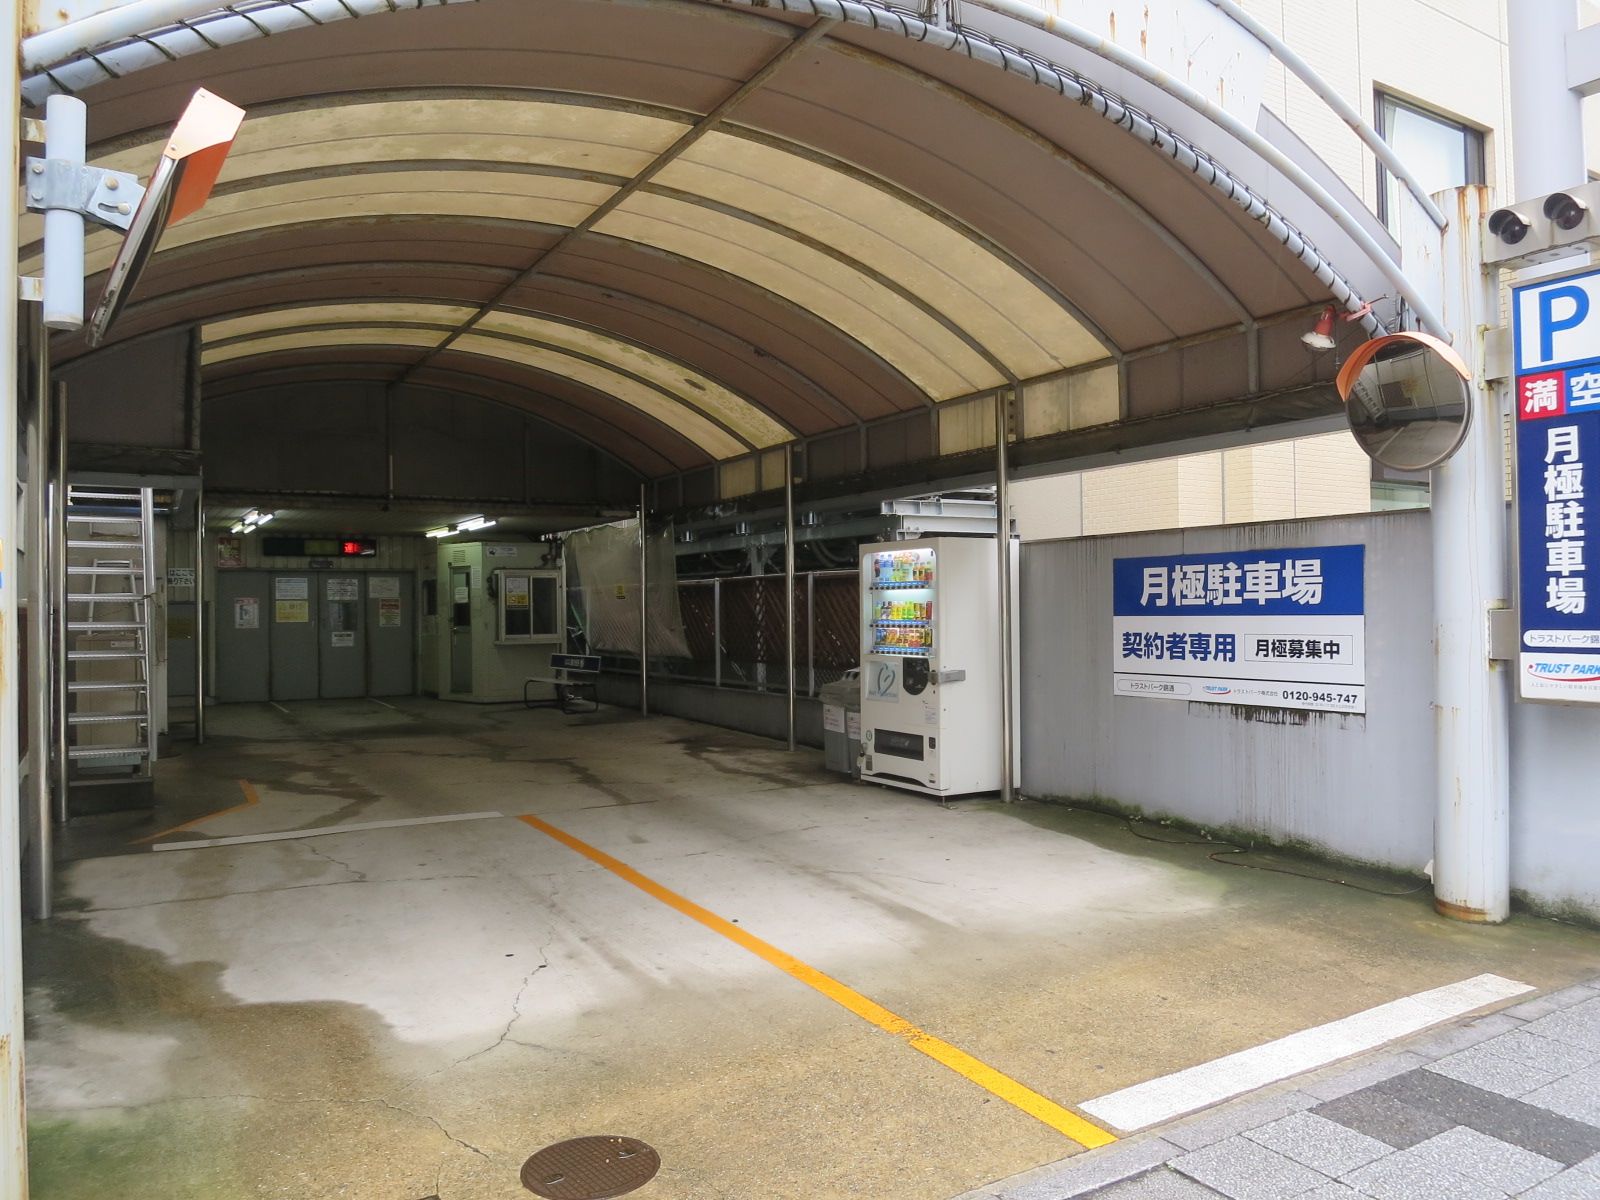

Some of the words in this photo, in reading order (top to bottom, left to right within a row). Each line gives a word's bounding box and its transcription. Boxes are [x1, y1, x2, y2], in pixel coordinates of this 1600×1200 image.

[1539, 285, 1590, 362] P
[1524, 378, 1559, 414] 満
[1570, 372, 1600, 408] 空
[1543, 425, 1586, 616] 月極駐車場
[1139, 558, 1324, 608] 月極駐車場
[1122, 631, 1236, 663] 契約者専用
[1255, 638, 1341, 660] 月極募集中
[1534, 662, 1571, 674] TRUST
[1282, 690, 1358, 704] 0120-945-747
